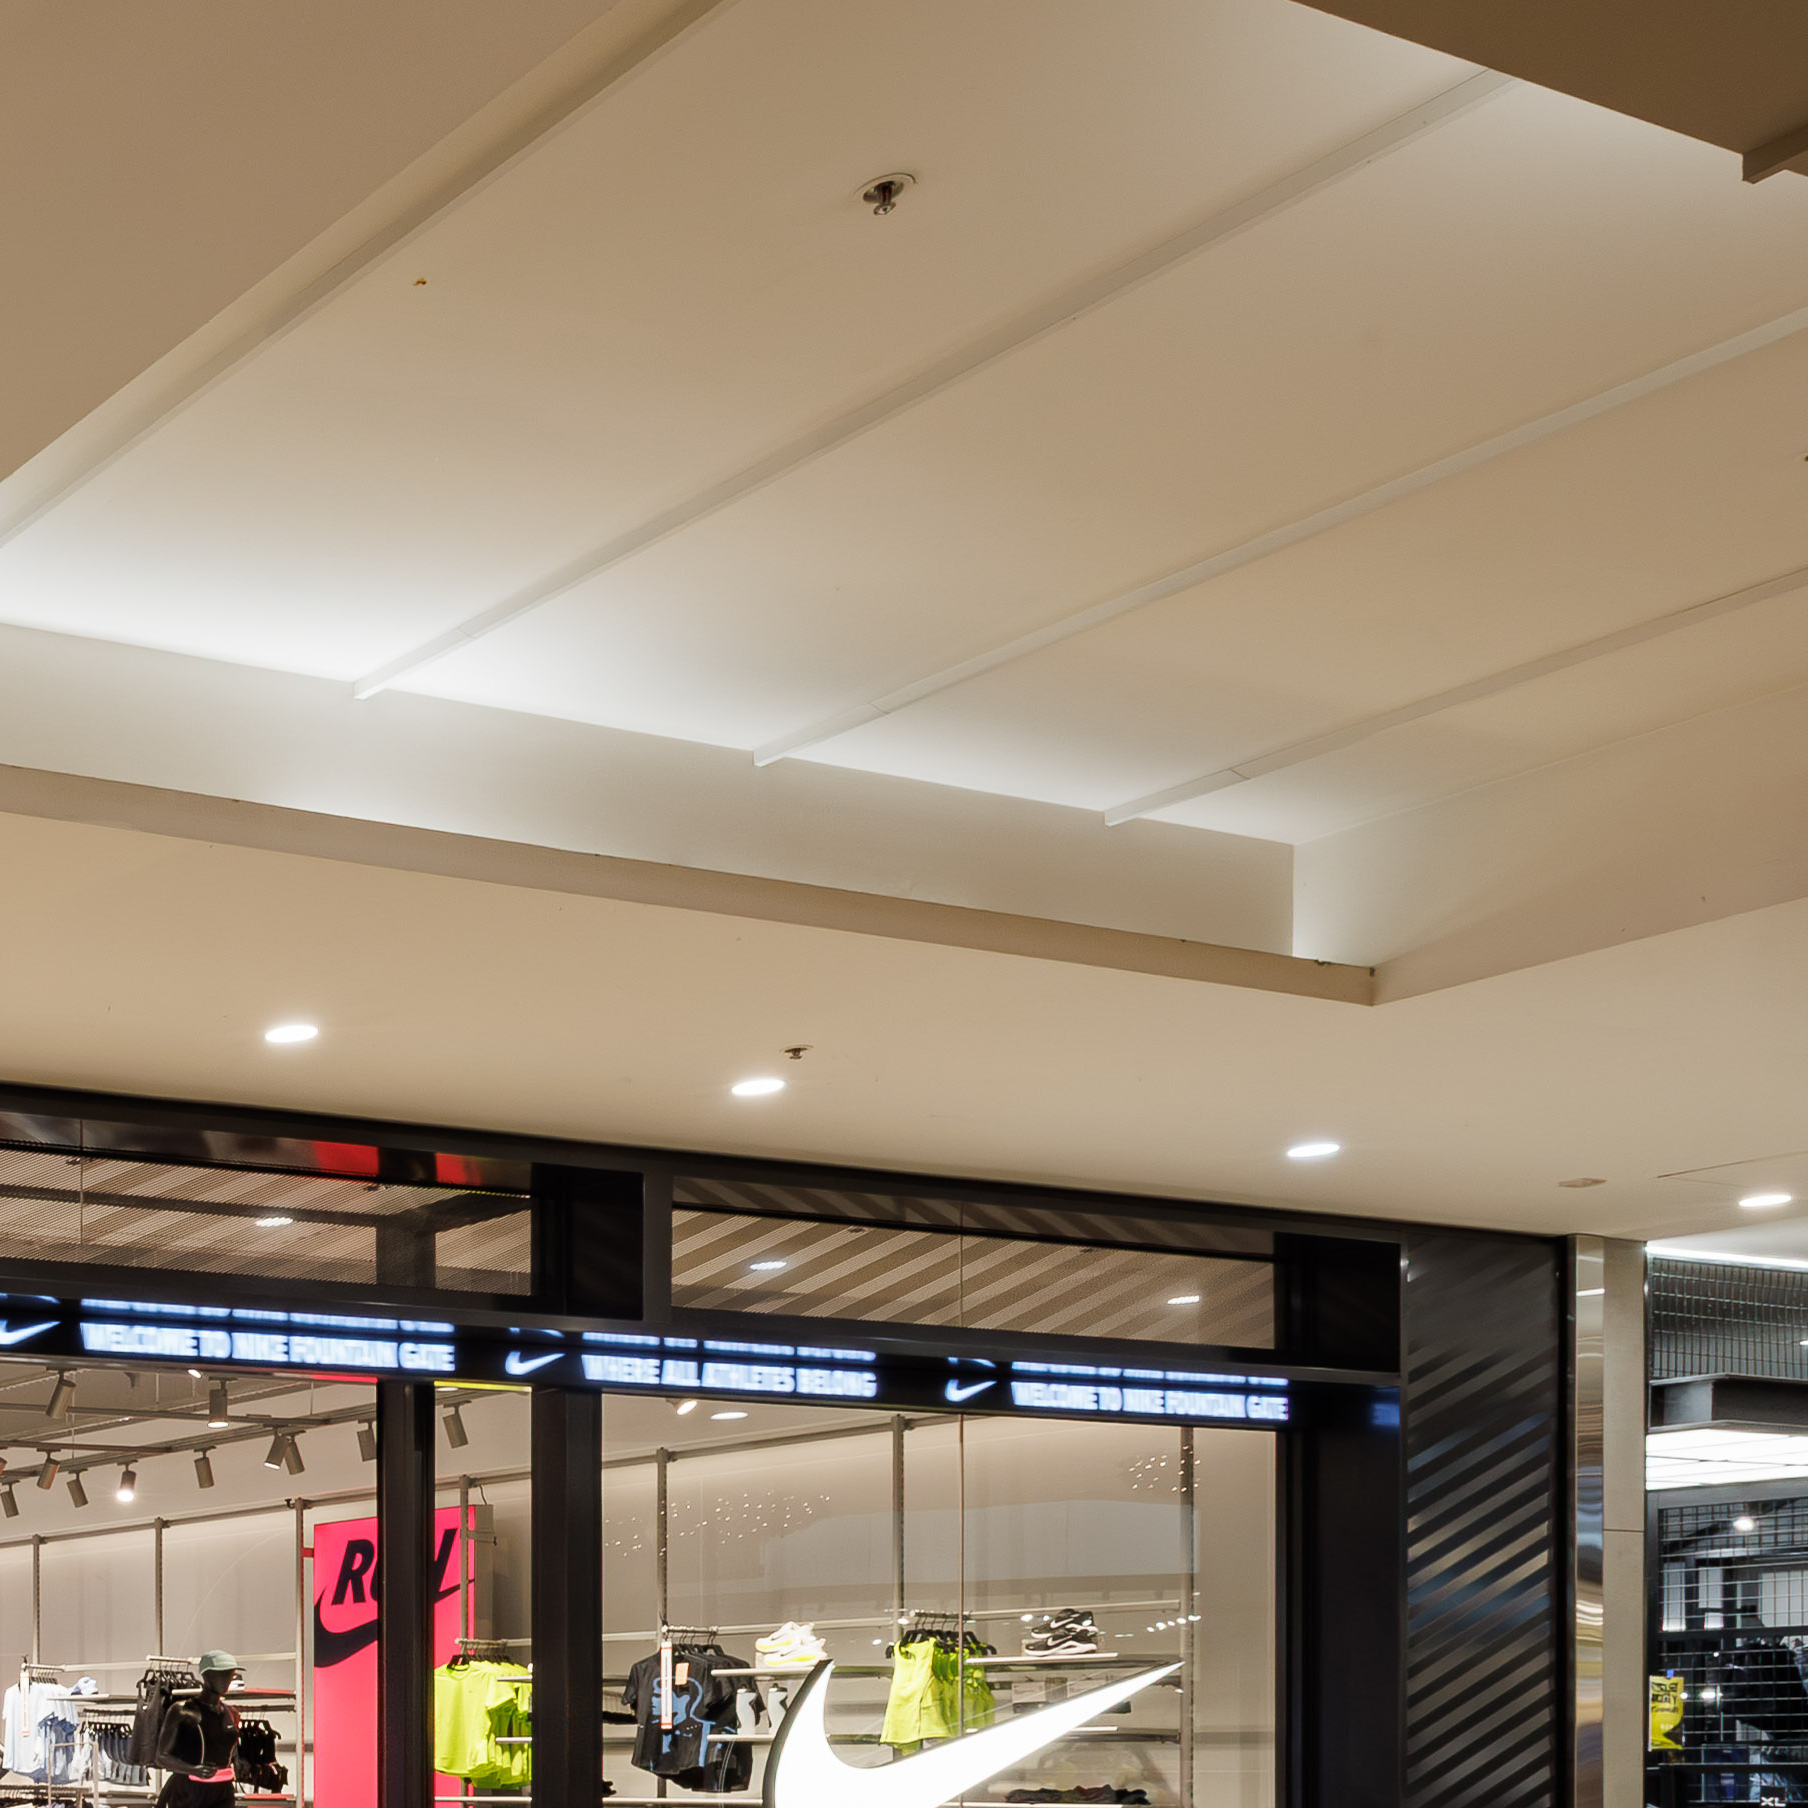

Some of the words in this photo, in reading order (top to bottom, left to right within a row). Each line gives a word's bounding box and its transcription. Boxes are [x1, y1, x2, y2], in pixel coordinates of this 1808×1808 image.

[80, 1323, 198, 1357] WELCOME
[232, 1332, 288, 1362] NIKE
[289, 1336, 398, 1368] FOUNTAIN
[399, 1342, 455, 1371] GATE
[581, 1354, 661, 1384] WHERE
[700, 1362, 795, 1393] ATHLETES
[796, 1368, 878, 1398] BELONG
[1011, 1381, 1098, 1410] WELCOME
[1761, 1797, 1786, 1807] XL
